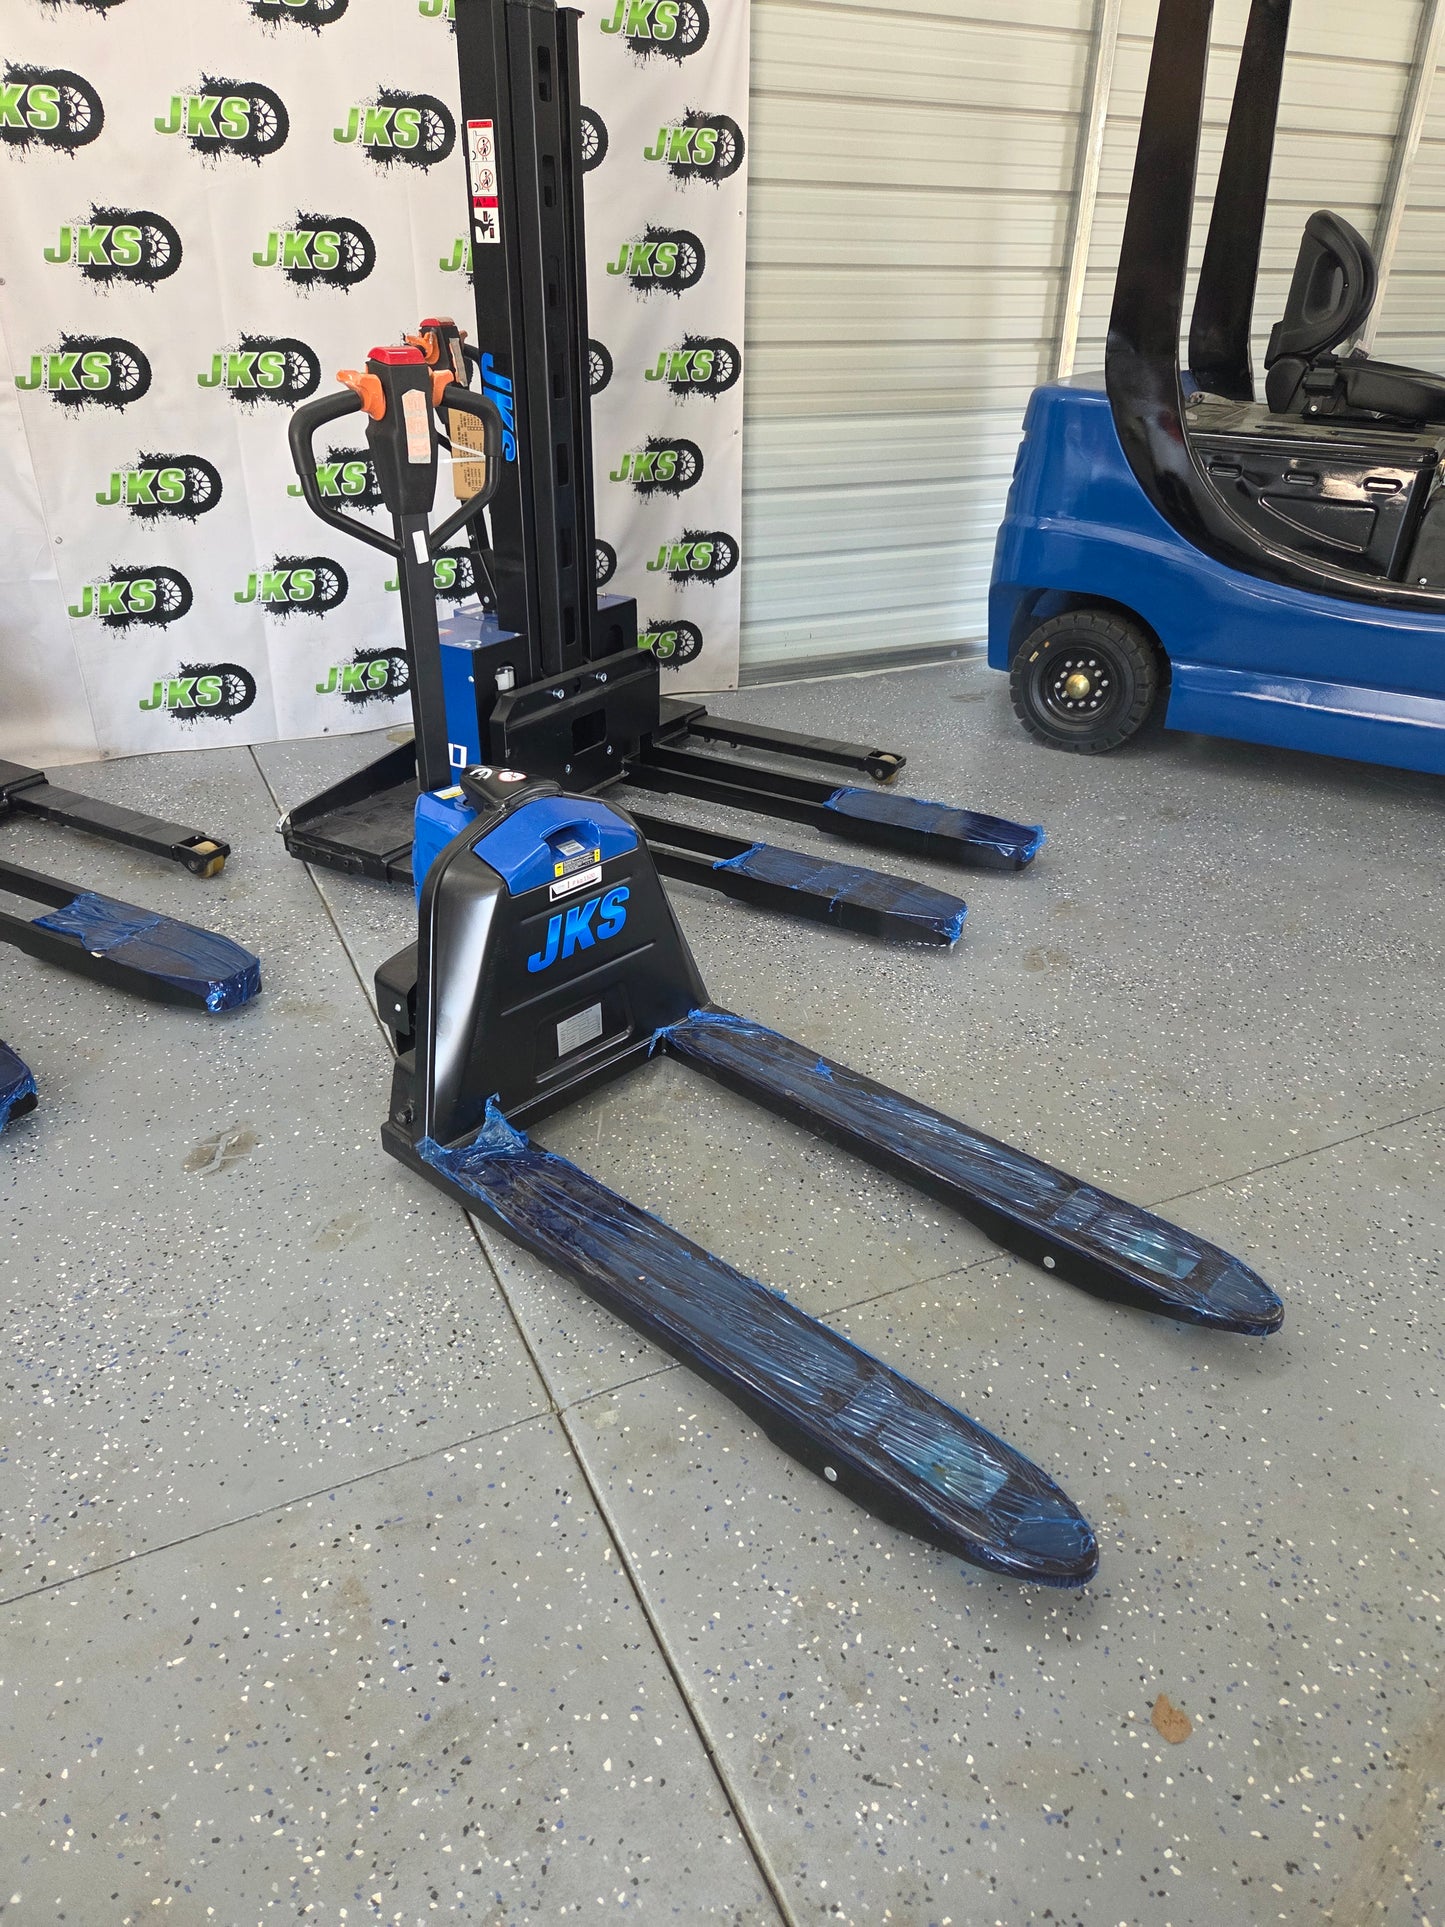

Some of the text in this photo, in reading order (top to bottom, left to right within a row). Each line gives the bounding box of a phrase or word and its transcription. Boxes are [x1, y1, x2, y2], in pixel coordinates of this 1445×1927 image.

[600, 0, 680, 41] JKS
[0, 83, 60, 130] KS
[154, 95, 250, 139] JKS
[333, 106, 422, 149] JKS
[643, 127, 718, 166] JKS
[43, 225, 143, 266] JKS
[252, 231, 341, 271] JKS
[606, 242, 679, 278] JKS
[14, 352, 112, 391] JKS
[196, 352, 286, 390] JKS
[644, 350, 714, 383] JKS
[609, 450, 678, 484] JKS
[95, 468, 187, 507] JKS
[646, 542, 715, 573] JKS
[68, 579, 157, 619] JKS
[233, 569, 316, 604] JKS
[637, 630, 678, 659] KS
[139, 676, 222, 711] JKS
[315, 659, 390, 695] JKS
[527, 885, 630, 974] JKS
